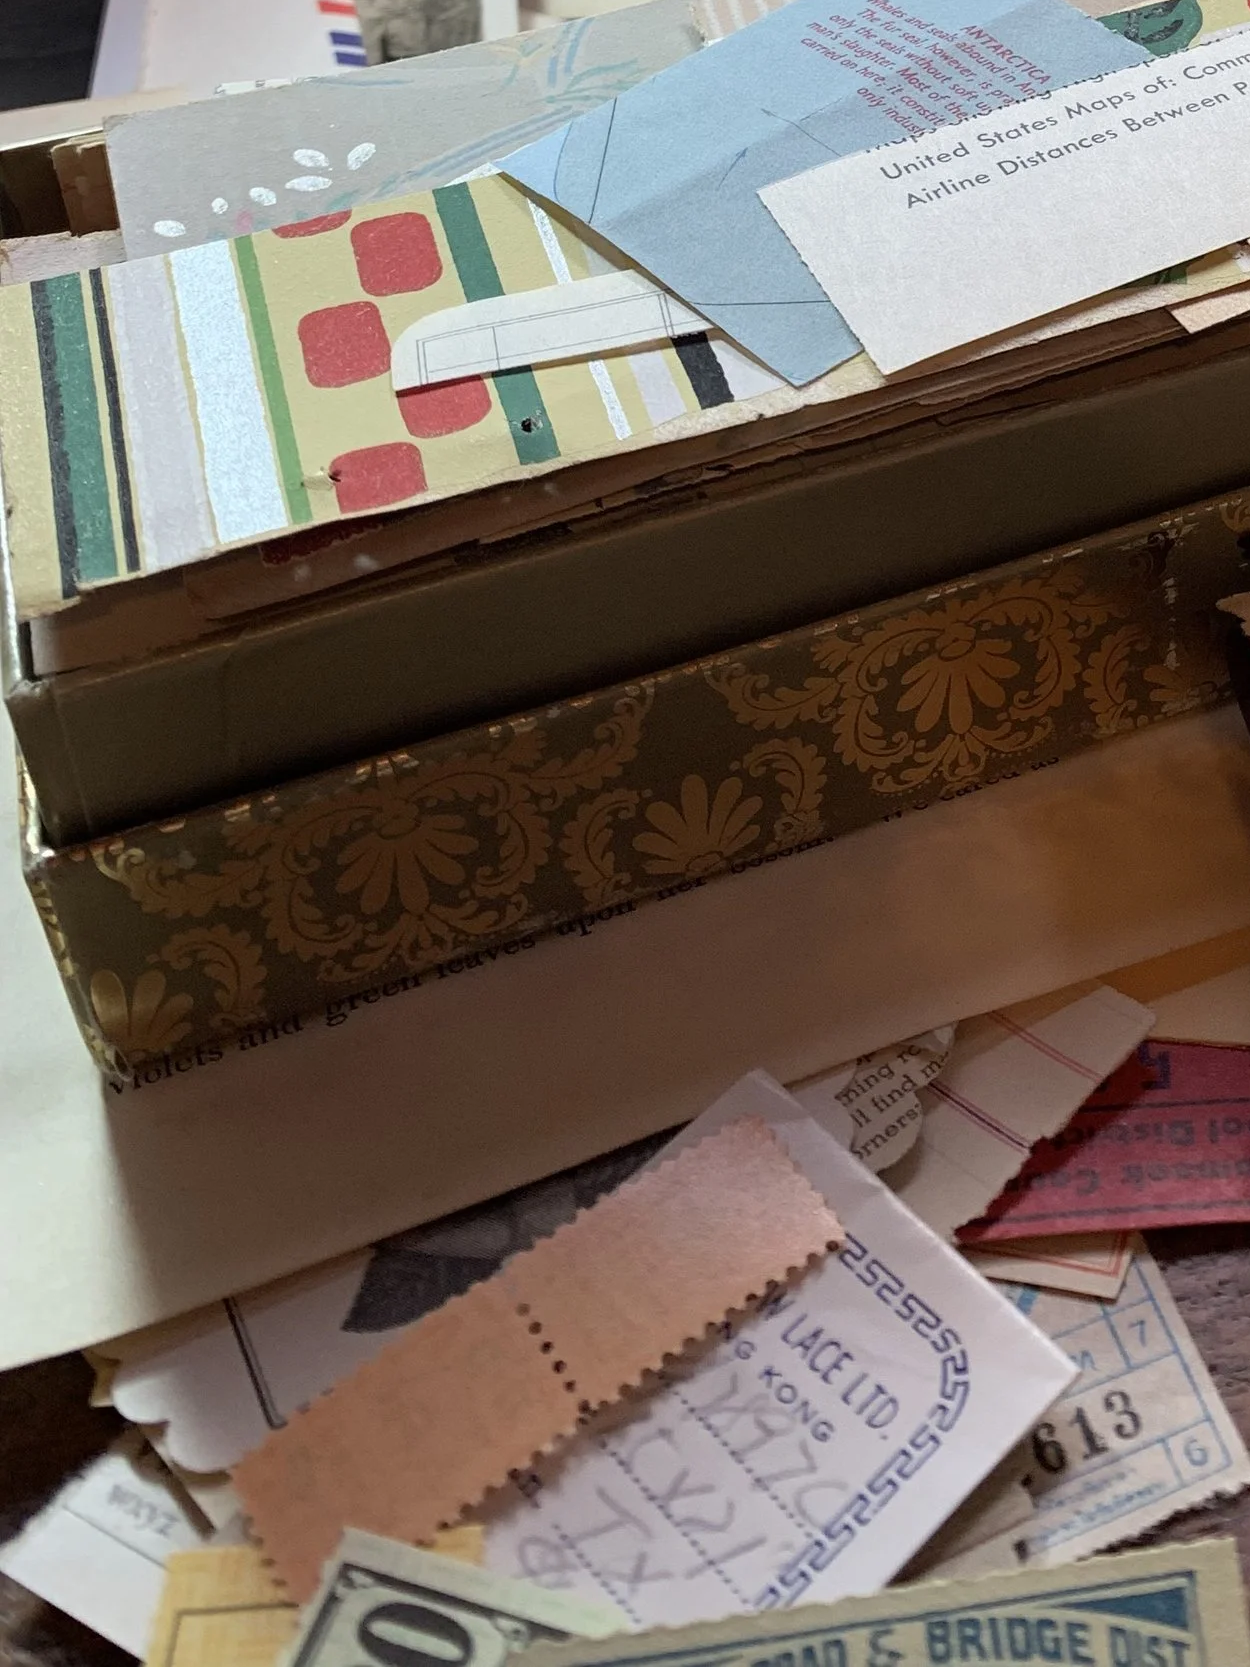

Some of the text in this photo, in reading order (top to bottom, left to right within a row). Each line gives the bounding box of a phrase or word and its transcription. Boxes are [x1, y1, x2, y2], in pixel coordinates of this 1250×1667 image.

[801, 37, 847, 61] carried
[840, 59, 858, 69] on
[806, 22, 969, 119] man's slaughter. Most of the
[829, 14, 858, 29] only
[855, 26, 876, 40] the
[876, 37, 907, 56] seals
[904, 51, 952, 84] without
[949, 83, 979, 102] soft
[857, 8, 881, 23] The
[880, 20, 902, 34] fur
[926, 42, 977, 82] however,
[904, 16, 935, 31] and
[928, 26, 957, 43] seals
[955, 41, 1005, 74] abound
[1001, 71, 1017, 83] in
[959, 25, 1052, 84] ANTARCTICA
[857, 87, 885, 108] only
[879, 142, 970, 181] United
[976, 114, 1059, 149] States
[1062, 90, 1136, 121] Maps
[1142, 74, 1179, 97] of:
[906, 171, 992, 210] Airline
[998, 125, 1118, 177] Distances
[1121, 89, 1231, 134] Between
[108, 1043, 224, 1095] violets
[238, 1013, 305, 1051] and
[325, 972, 423, 1027] green
[436, 931, 536, 979] leaves
[871, 1074, 918, 1115] find
[1128, 1319, 1147, 1348] 7
[757, 1365, 836, 1443] KONG
[780, 1312, 856, 1385] LACE
[840, 1372, 901, 1440] LTD.
[1183, 1437, 1209, 1467] 6
[926, 1615, 1096, 1667] BRIDGE
